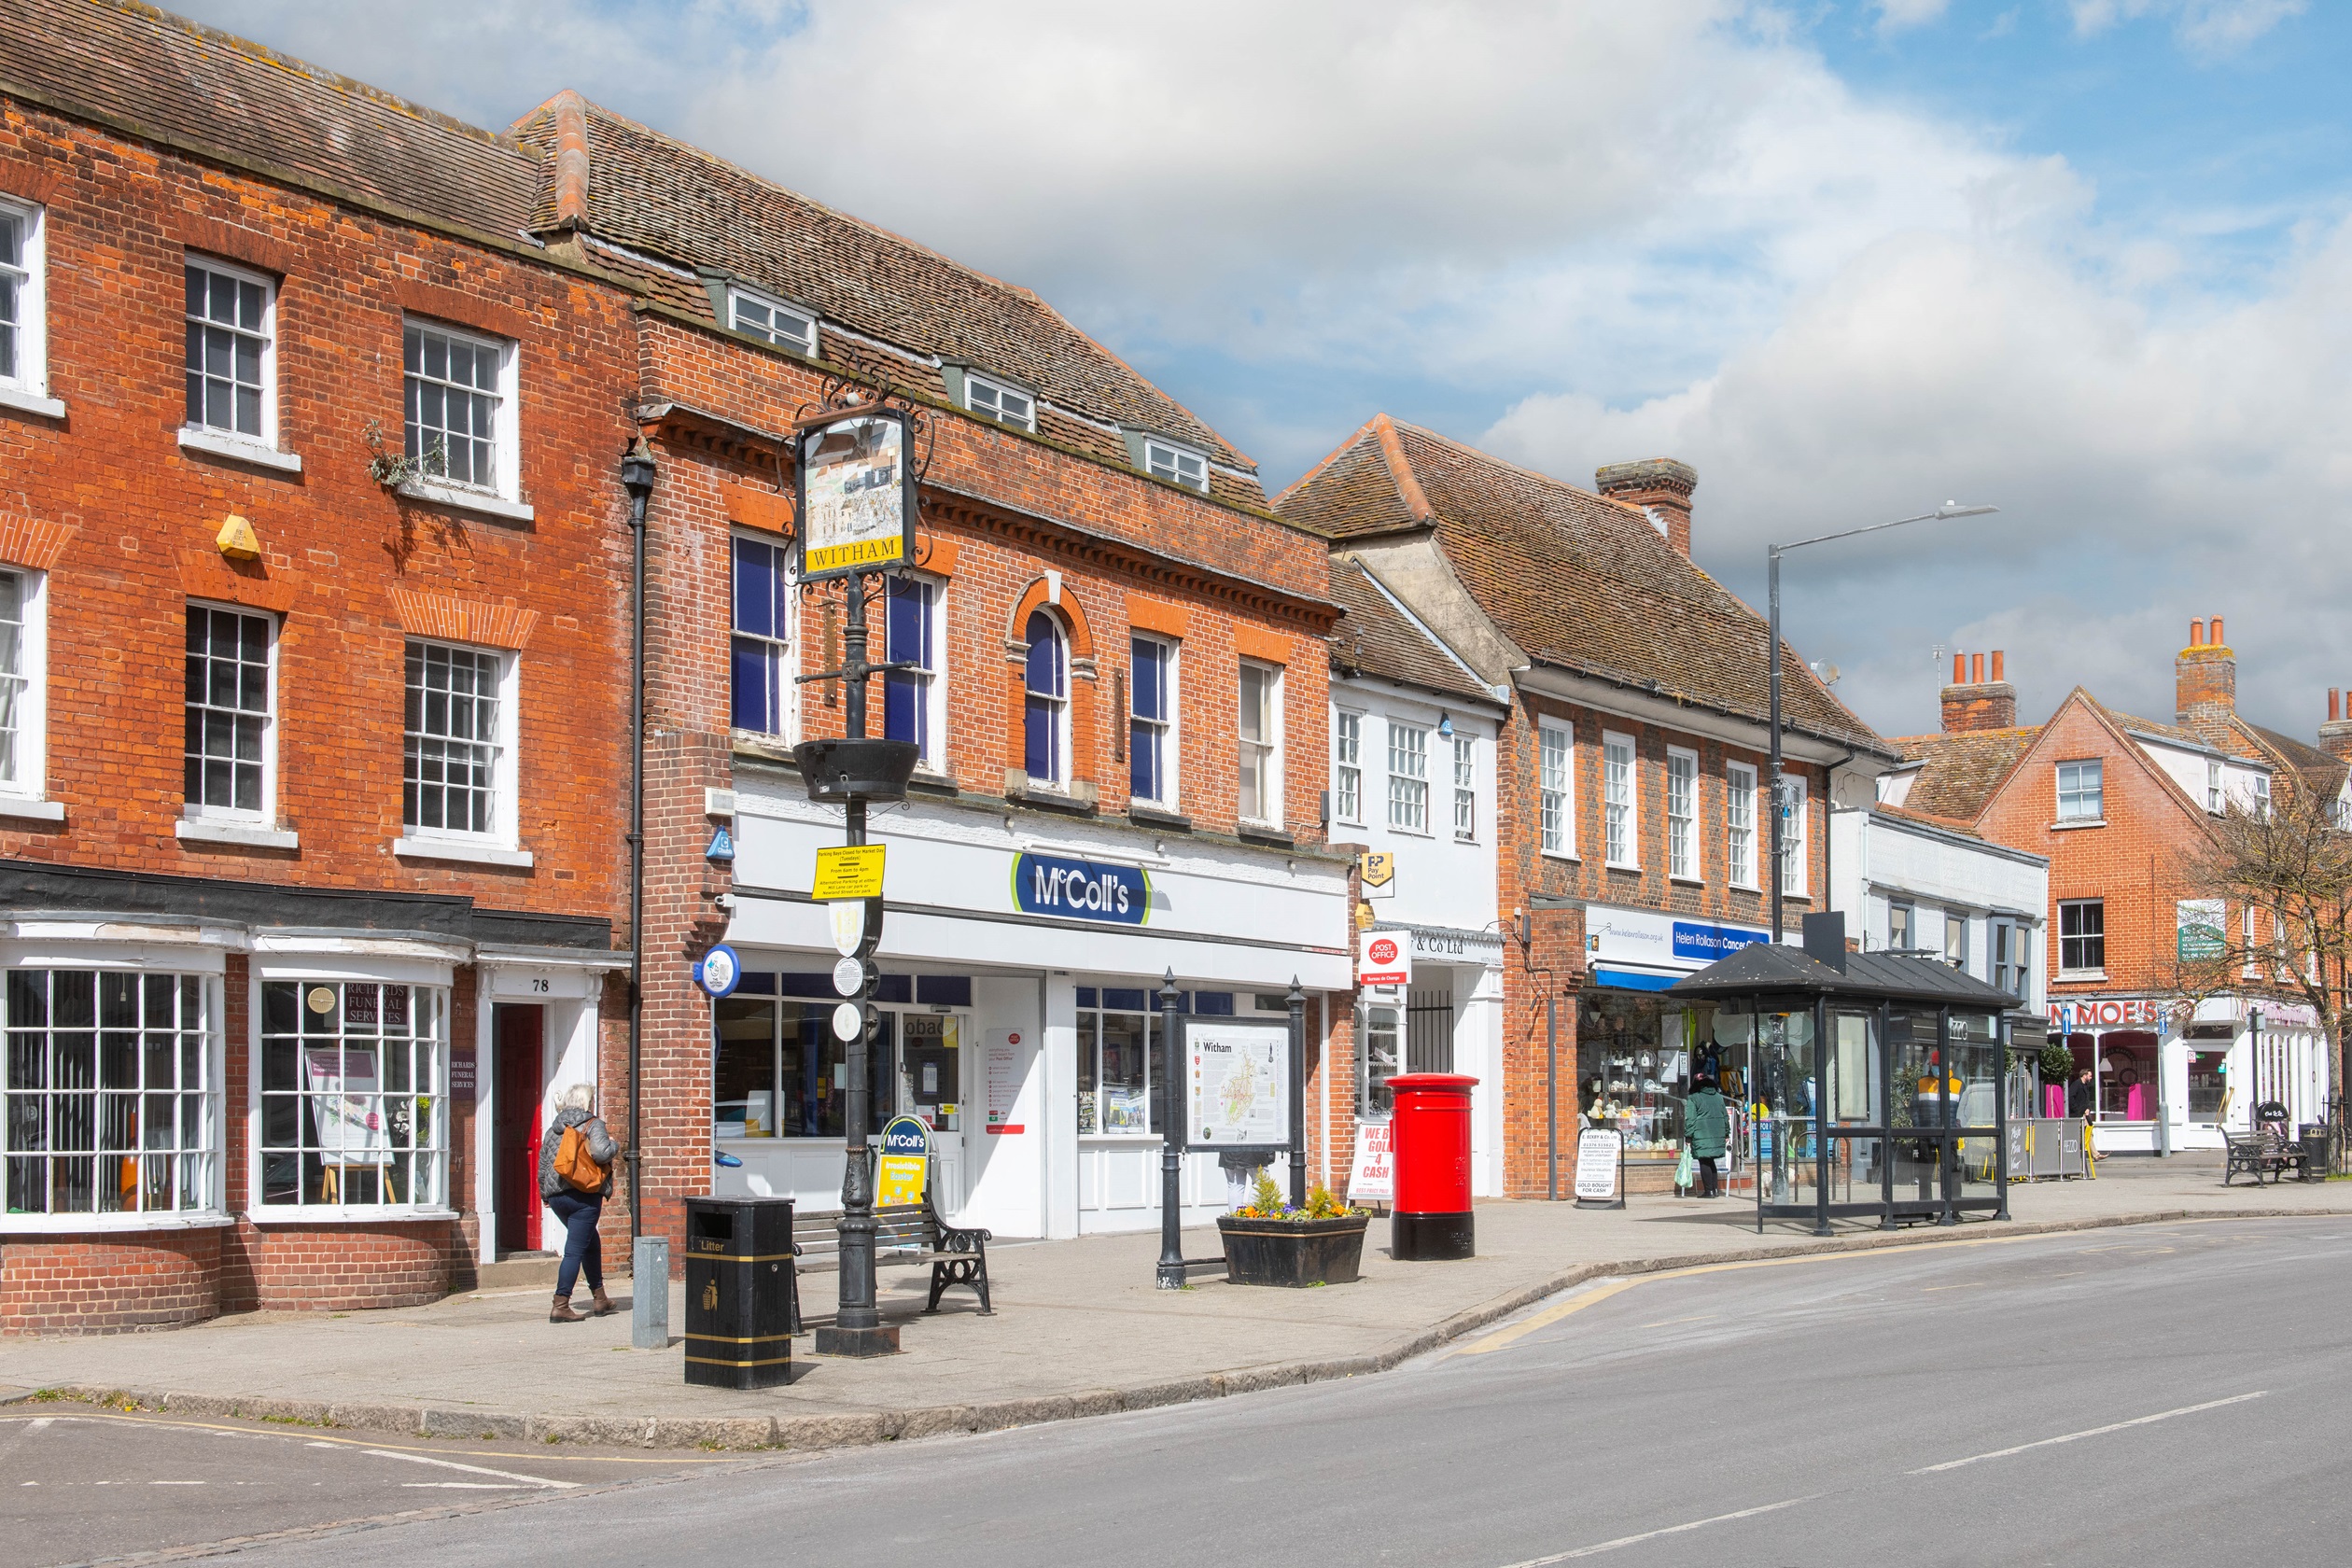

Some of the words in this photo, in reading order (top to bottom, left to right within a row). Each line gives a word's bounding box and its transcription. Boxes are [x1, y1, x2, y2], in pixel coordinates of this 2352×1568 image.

[814, 539, 895, 567] WITHAM
[1035, 864, 1129, 915] McColl's
[1417, 937, 1425, 951] &
[1429, 937, 1443, 952] Co
[1447, 938, 1463, 954] Ltd
[1676, 931, 1694, 945] Helen
[1695, 934, 1721, 948] Rollason
[1722, 937, 1745, 950] Cancer
[1371, 951, 1394, 959] OFFICE
[533, 979, 549, 992] 78
[350, 1010, 400, 1023] SERVCES
[2077, 1001, 2158, 1025] MOE'S
[1203, 1042, 1232, 1053] Witham
[1365, 1127, 1380, 1139] WE
[887, 1134, 925, 1147] McColl's
[1375, 1153, 1382, 1165] 4
[886, 1161, 921, 1171] Irresistible
[1363, 1166, 1389, 1178] CASH
[890, 1172, 914, 1182] Easter
[701, 1240, 725, 1252] Litter
